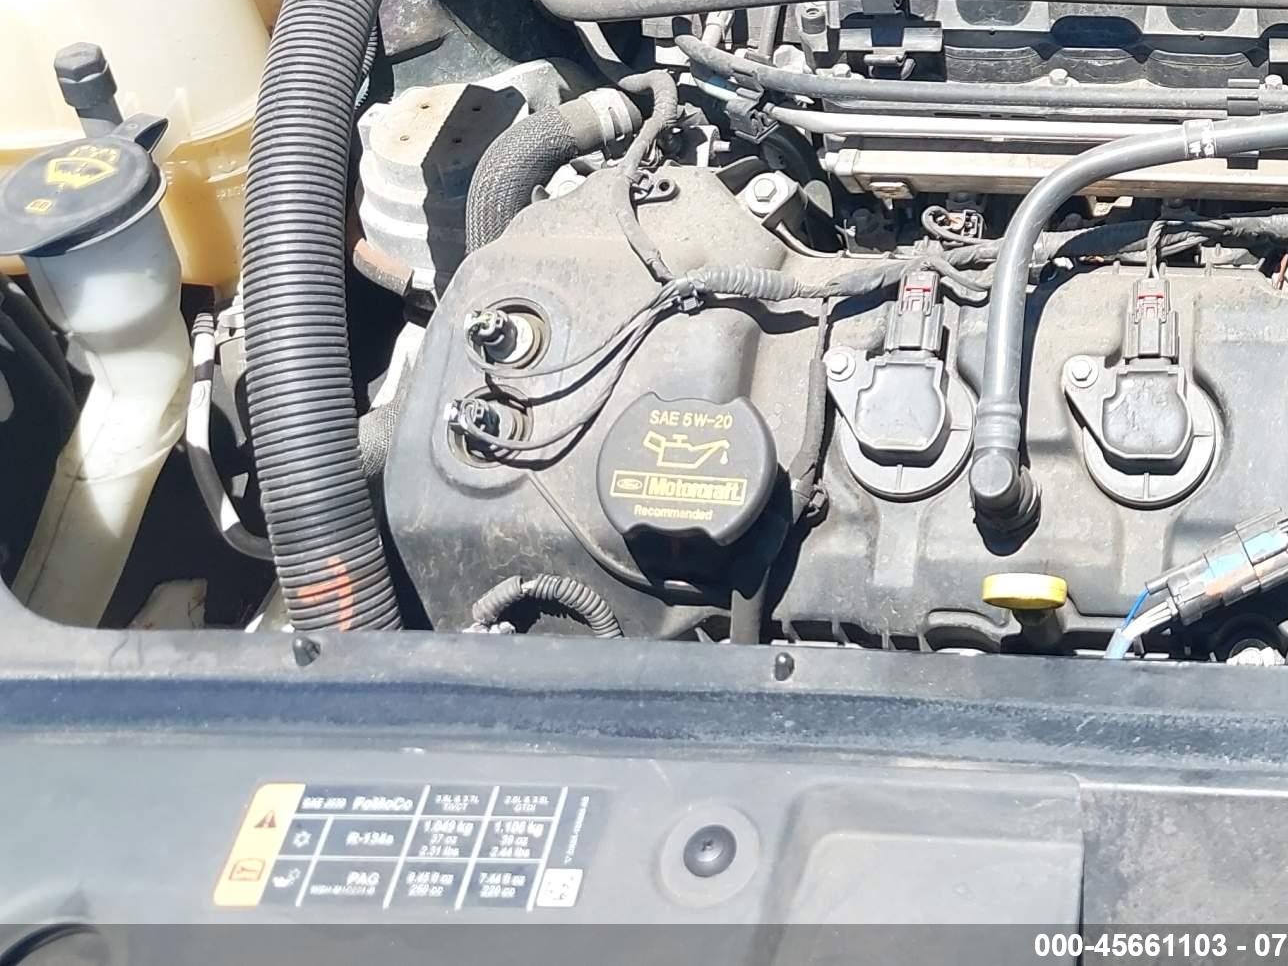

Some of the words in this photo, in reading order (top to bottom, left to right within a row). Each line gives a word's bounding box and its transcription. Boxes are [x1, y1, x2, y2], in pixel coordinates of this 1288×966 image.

[650, 409, 680, 427] SAE
[682, 411, 733, 430] 5W-20
[648, 476, 741, 500] Motorcraft
[634, 505, 713, 521] Recommended
[352, 796, 414, 811] FoMoCo
[457, 821, 474, 837] kg
[527, 821, 544, 838] kg
[346, 831, 395, 846] R-134a
[347, 871, 381, 886] PAG
